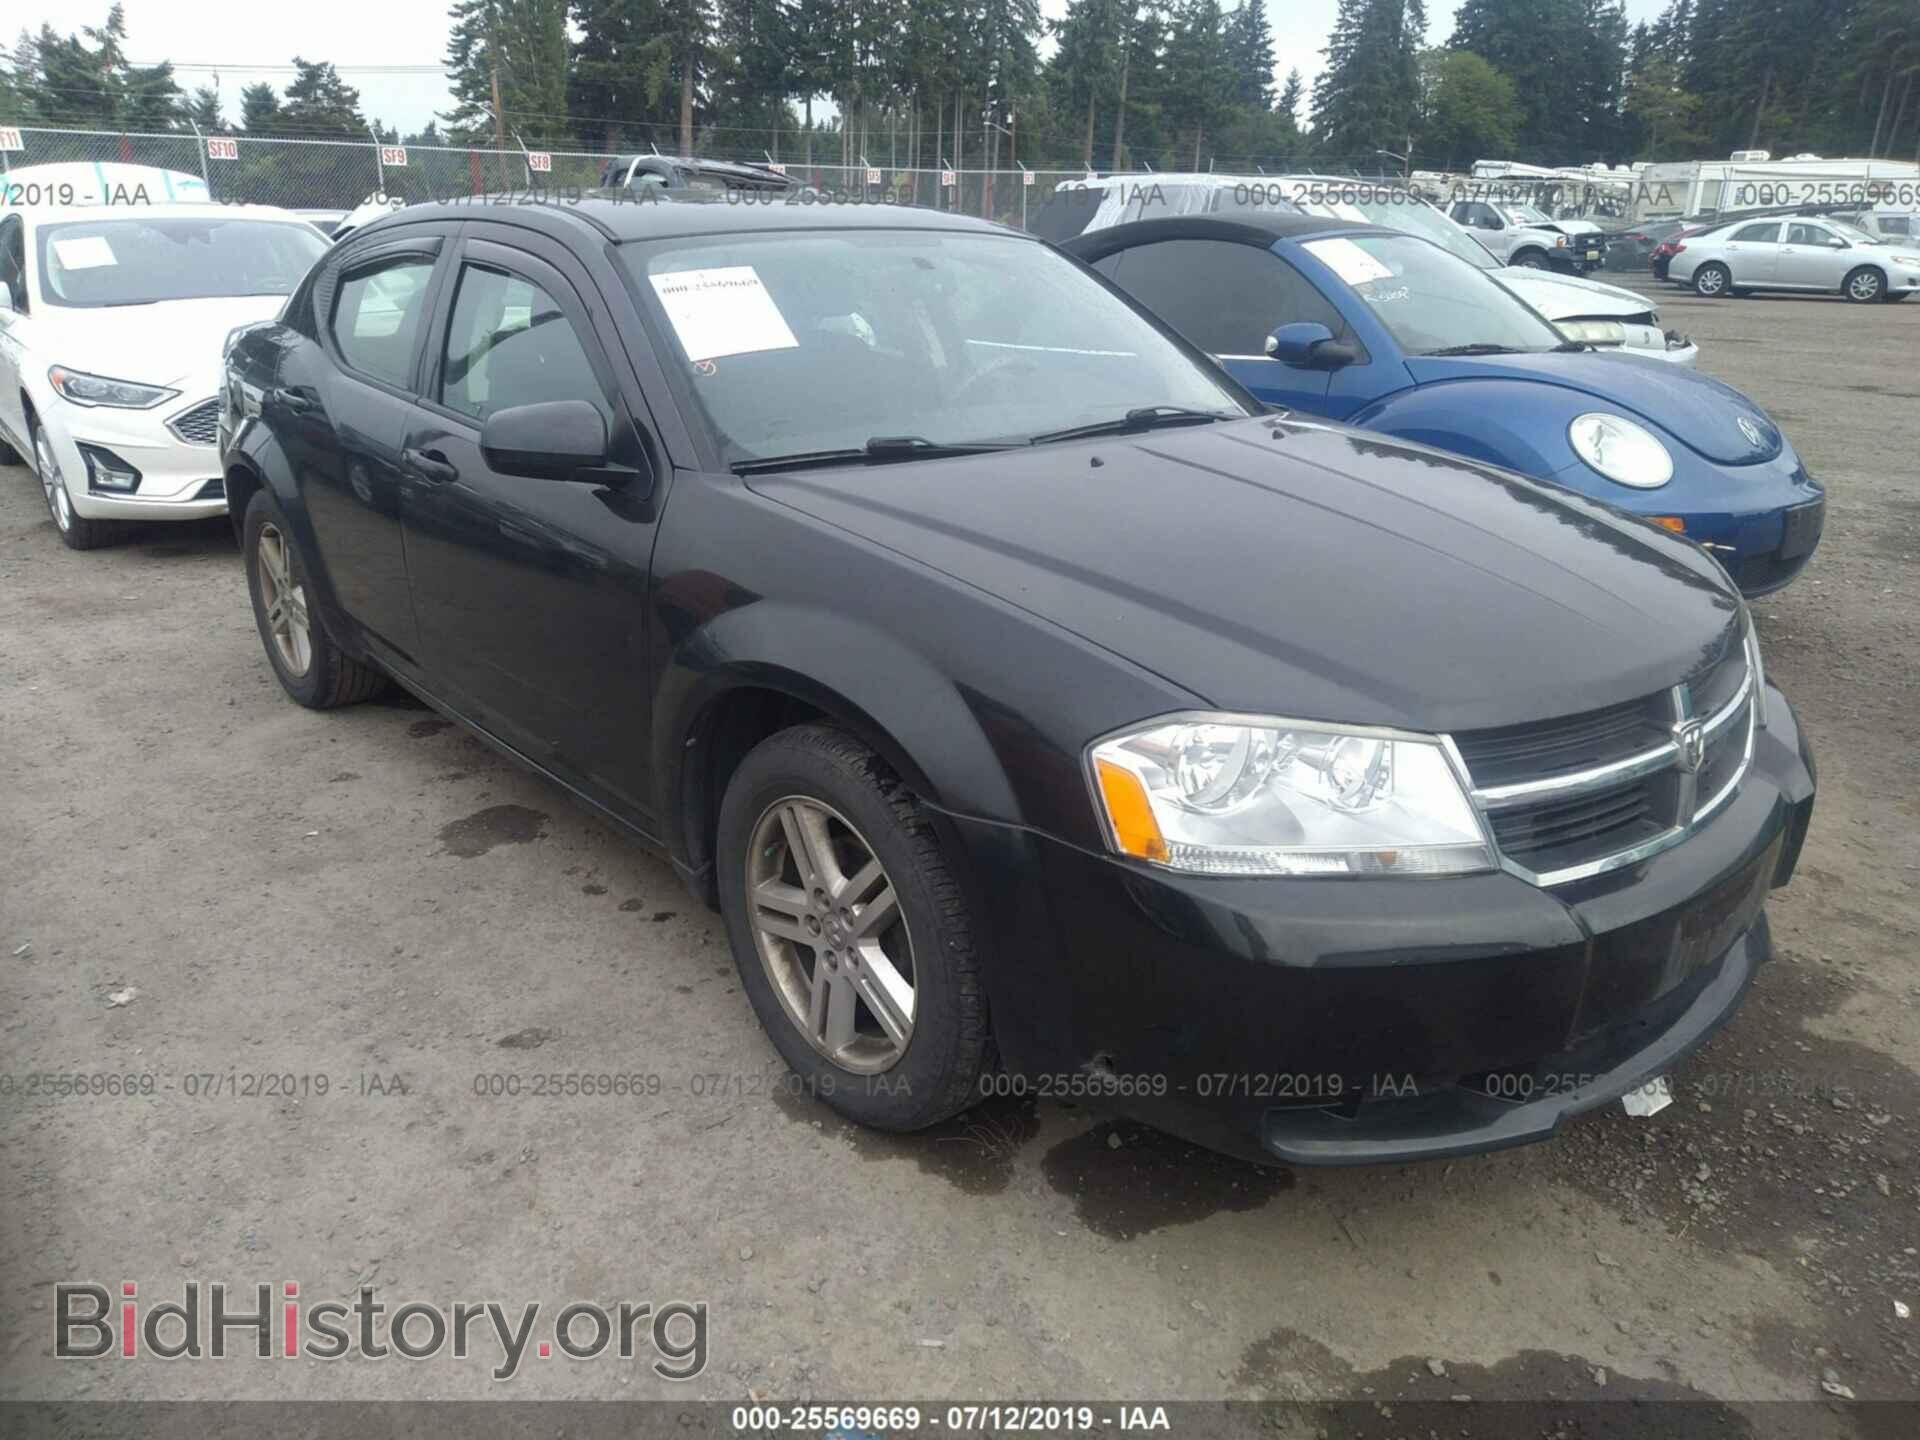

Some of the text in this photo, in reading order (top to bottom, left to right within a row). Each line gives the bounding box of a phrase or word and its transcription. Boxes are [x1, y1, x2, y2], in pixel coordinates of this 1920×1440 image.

[208, 140, 236, 158] SF10
[383, 150, 406, 164] SF9
[530, 154, 550, 169] SF8
